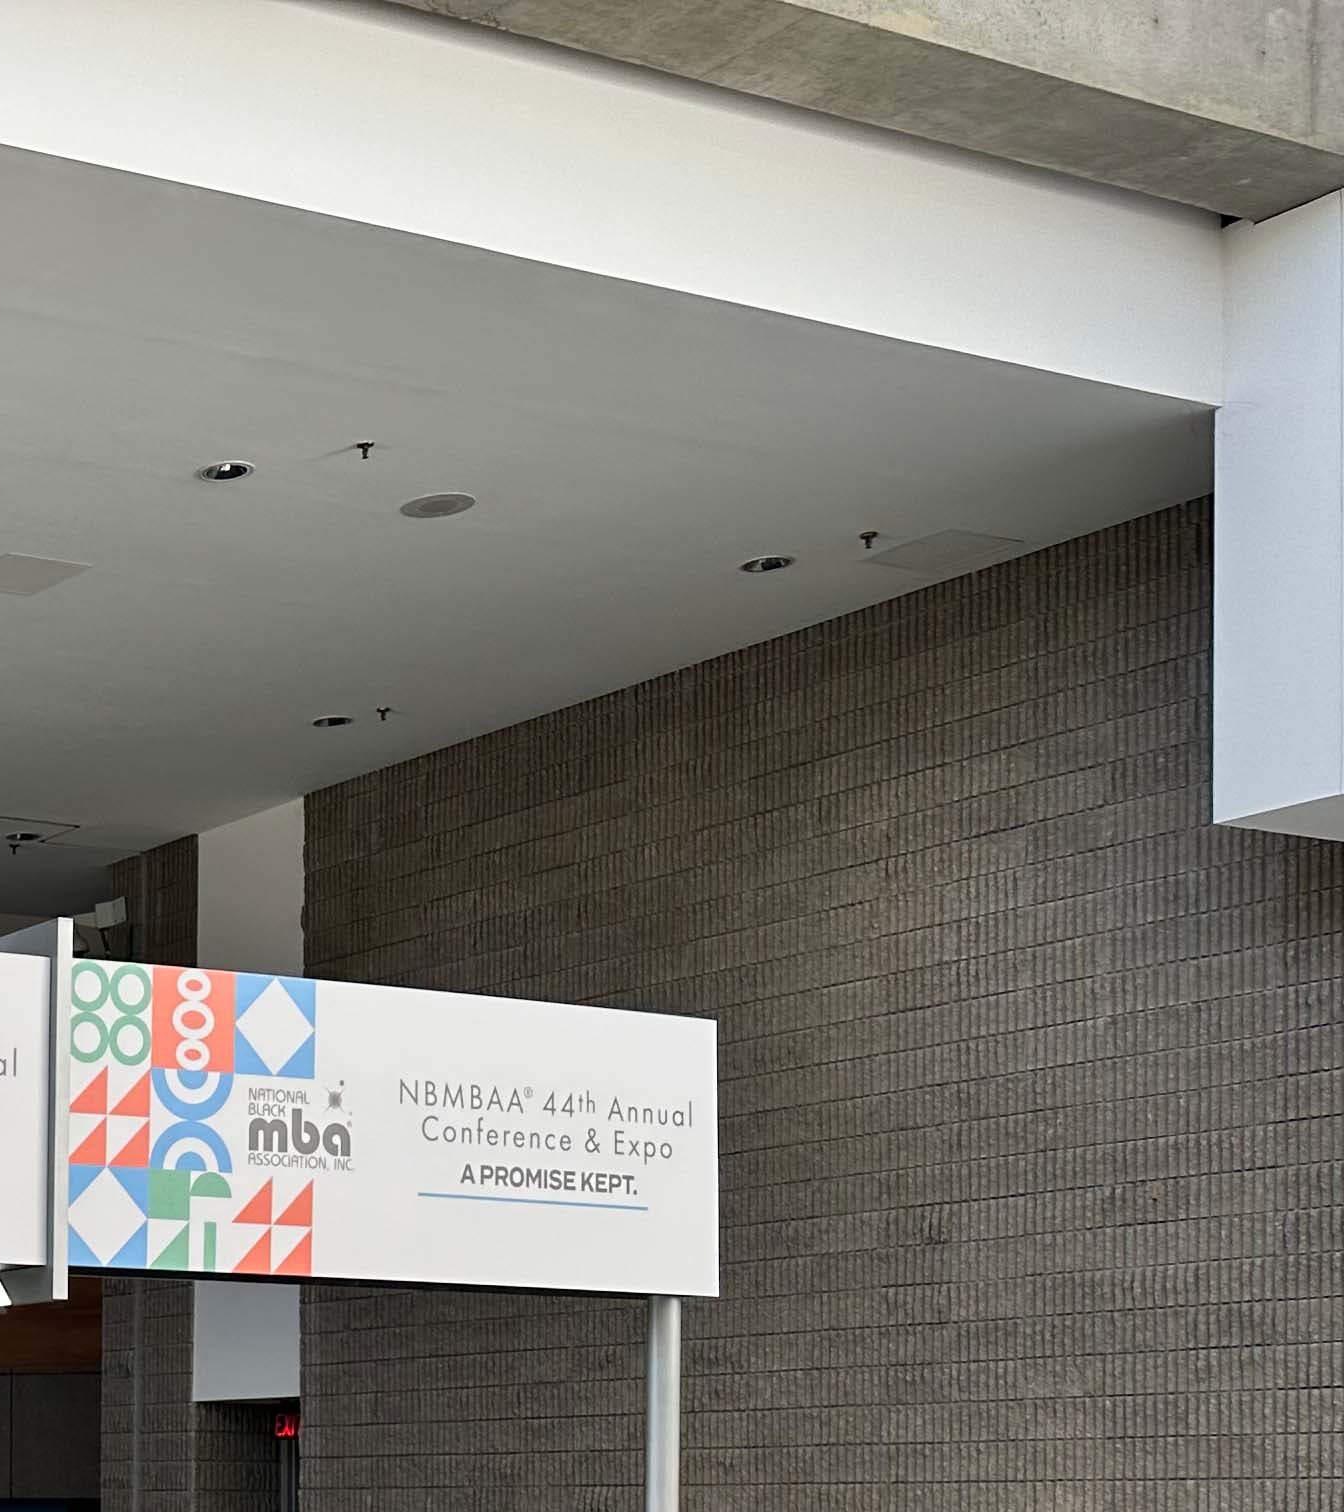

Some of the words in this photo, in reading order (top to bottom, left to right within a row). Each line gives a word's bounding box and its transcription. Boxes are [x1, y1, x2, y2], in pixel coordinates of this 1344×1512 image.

[248, 1088, 310, 1105] NATIONAL
[248, 1102, 286, 1117] BLACK
[543, 1090, 596, 1117] 44th
[608, 1096, 692, 1128] Annual
[422, 1115, 572, 1151] Conference
[584, 1127, 601, 1154] &
[614, 1130, 673, 1164] Expo
[248, 1152, 330, 1170] ASSOCIATION,
[460, 1163, 475, 1184] A
[480, 1165, 576, 1191] PROMISE
[581, 1171, 638, 1195] KEPT.
[274, 1414, 300, 1438] EXI
